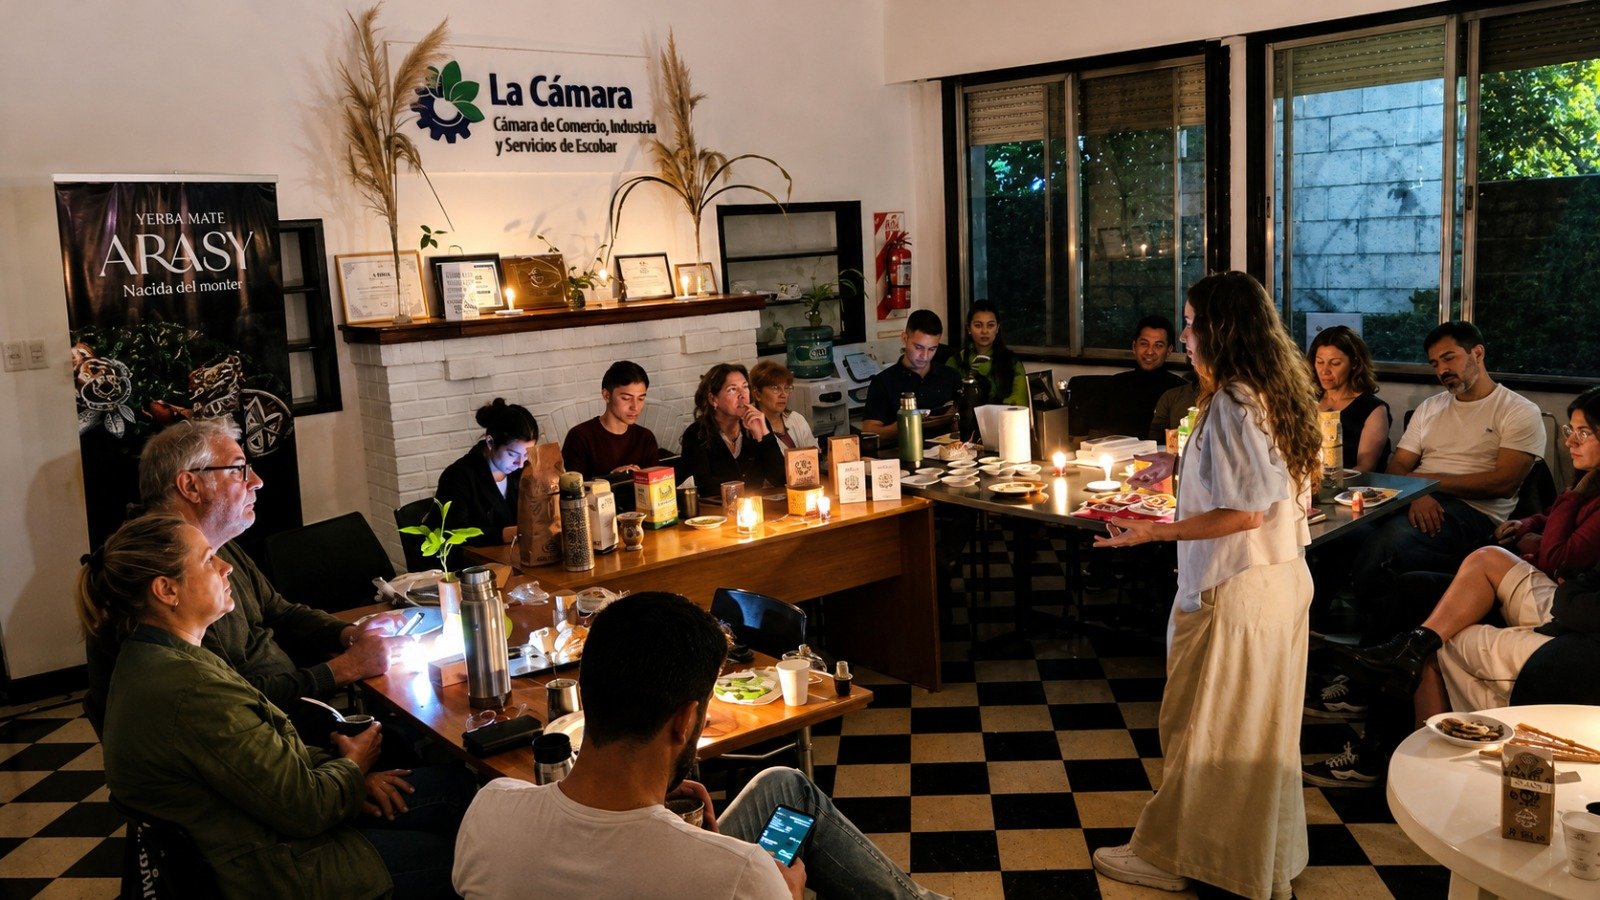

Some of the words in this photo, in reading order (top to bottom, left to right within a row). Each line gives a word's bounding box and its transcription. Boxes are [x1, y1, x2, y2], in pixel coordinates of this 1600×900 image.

[489, 73, 524, 106] La
[530, 74, 633, 109] Cámara
[493, 116, 538, 132] Cámara
[540, 118, 555, 132] de
[557, 118, 610, 137] Comercio,
[610, 119, 657, 134] Industria
[495, 140, 503, 156] y
[505, 138, 557, 153] Servicios
[560, 138, 574, 152] de
[576, 138, 617, 153] Escobar
[136, 212, 184, 225] YERBA
[188, 212, 226, 224] MATE
[100, 231, 254, 277] ARASY
[123, 282, 173, 297] Nacida
[176, 281, 197, 293] del
